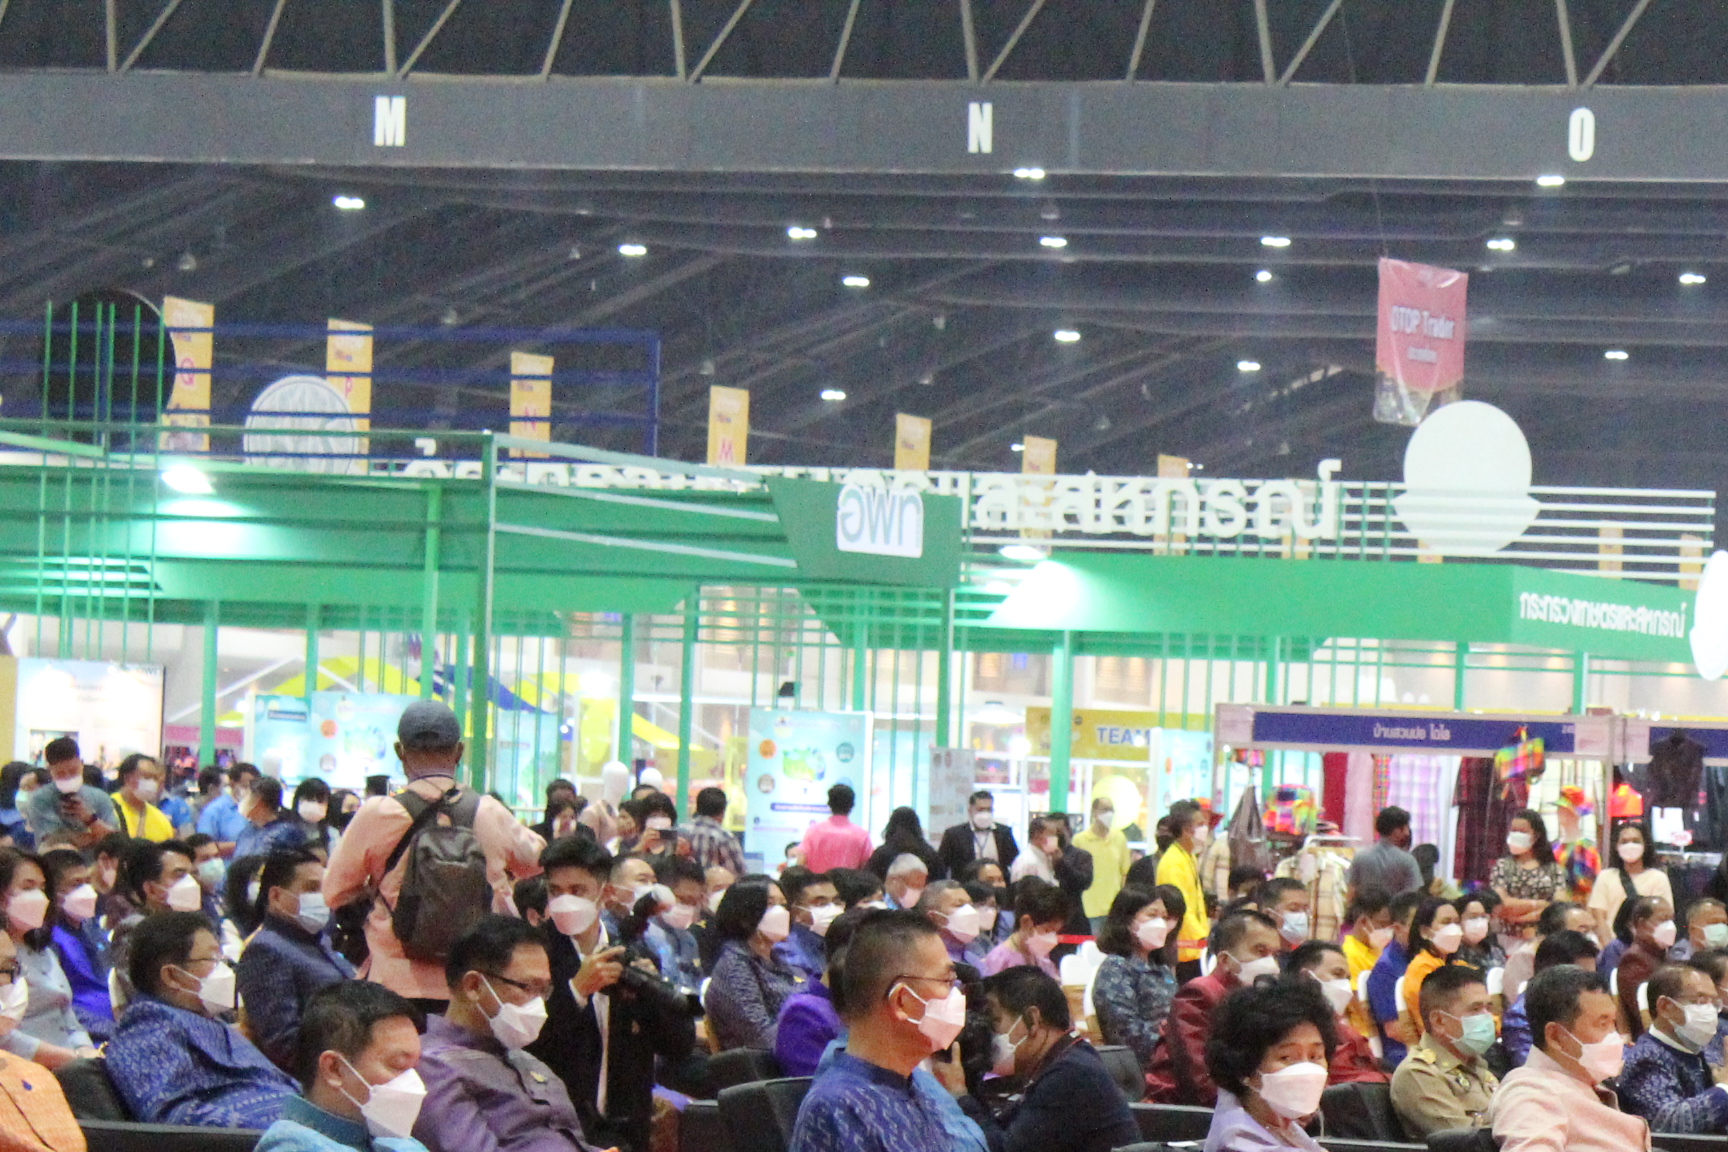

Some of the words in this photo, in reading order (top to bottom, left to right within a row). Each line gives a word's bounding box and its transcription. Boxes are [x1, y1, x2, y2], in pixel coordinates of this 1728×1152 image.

[374, 95, 406, 146] M
[967, 102, 993, 154] N
[1568, 107, 1596, 162] O
[1390, 305, 1420, 334] OTOP
[1422, 310, 1455, 339] Trader
[1519, 591, 1687, 639] กระทรวงเกษตรและสหกรณ์
